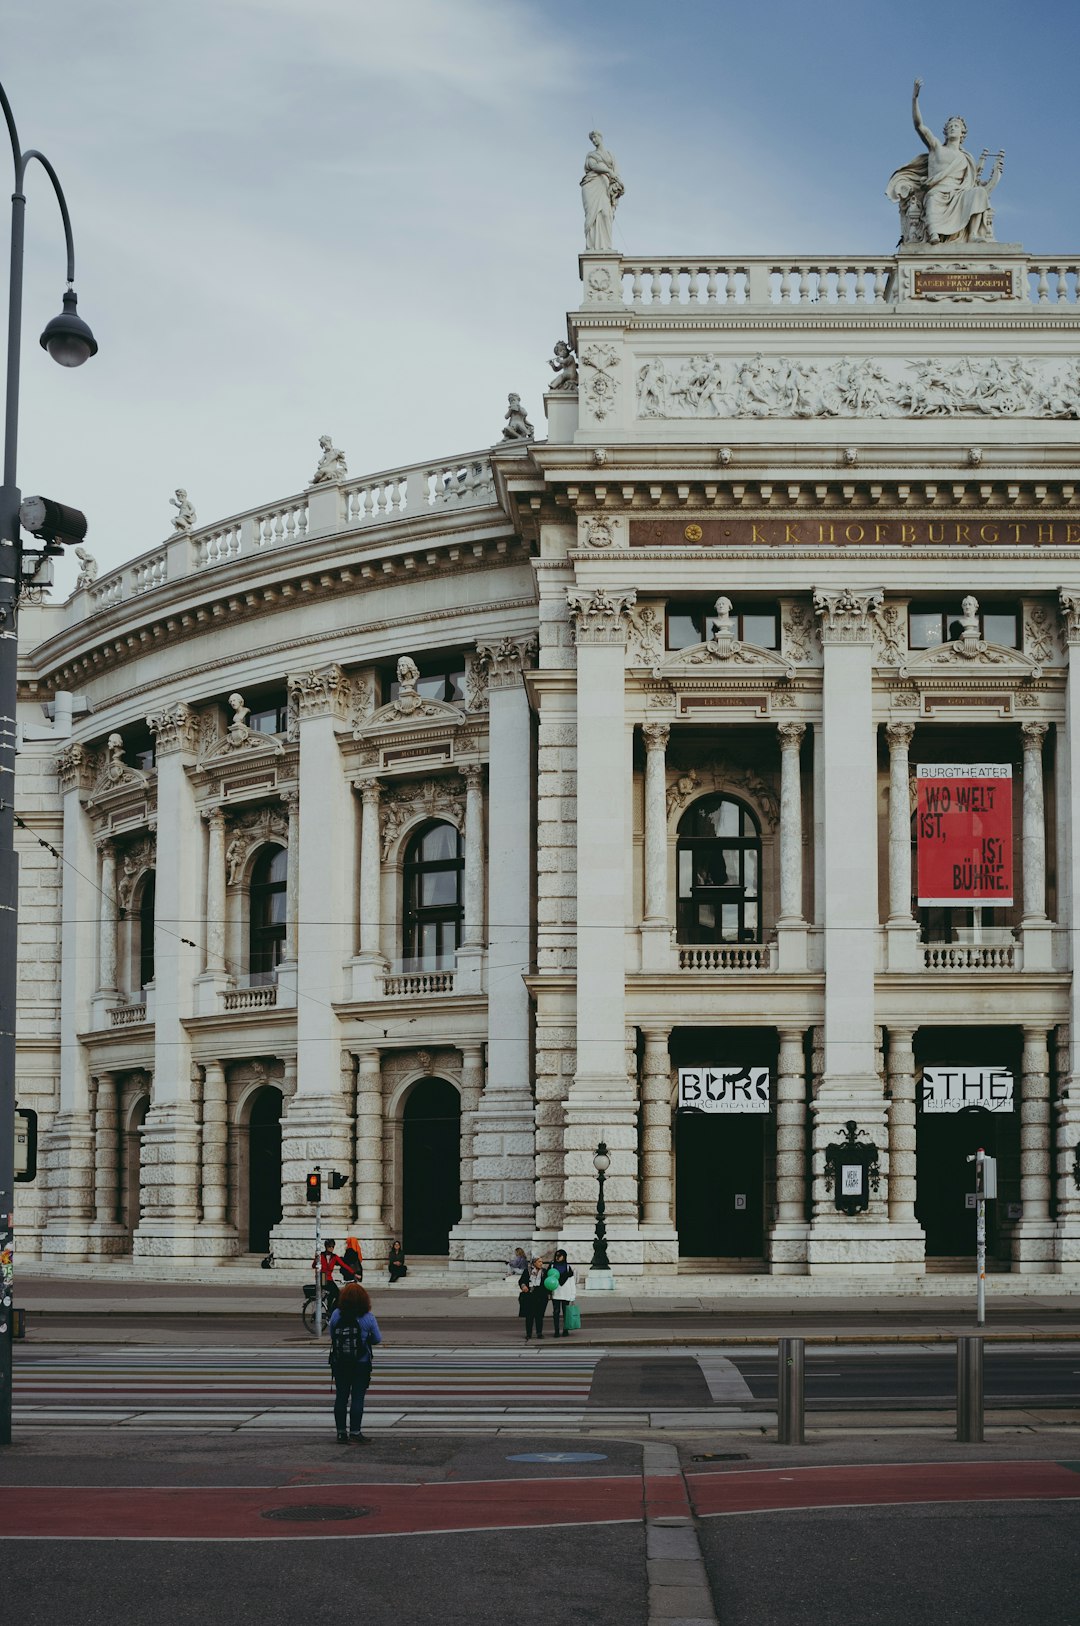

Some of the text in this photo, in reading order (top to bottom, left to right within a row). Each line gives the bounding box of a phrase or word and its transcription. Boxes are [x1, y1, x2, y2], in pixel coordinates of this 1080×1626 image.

[921, 767, 1008, 778] BURGTHEATER
[925, 786, 996, 813] WO WELT
[921, 812, 947, 843] IST,
[982, 838, 1006, 864] IST
[953, 858, 1009, 890] BÜHNE.
[682, 1100, 766, 1109] BURGTHEATER
[927, 1100, 1012, 1109] BURGTHEATER
[968, 1196, 974, 1206] E
